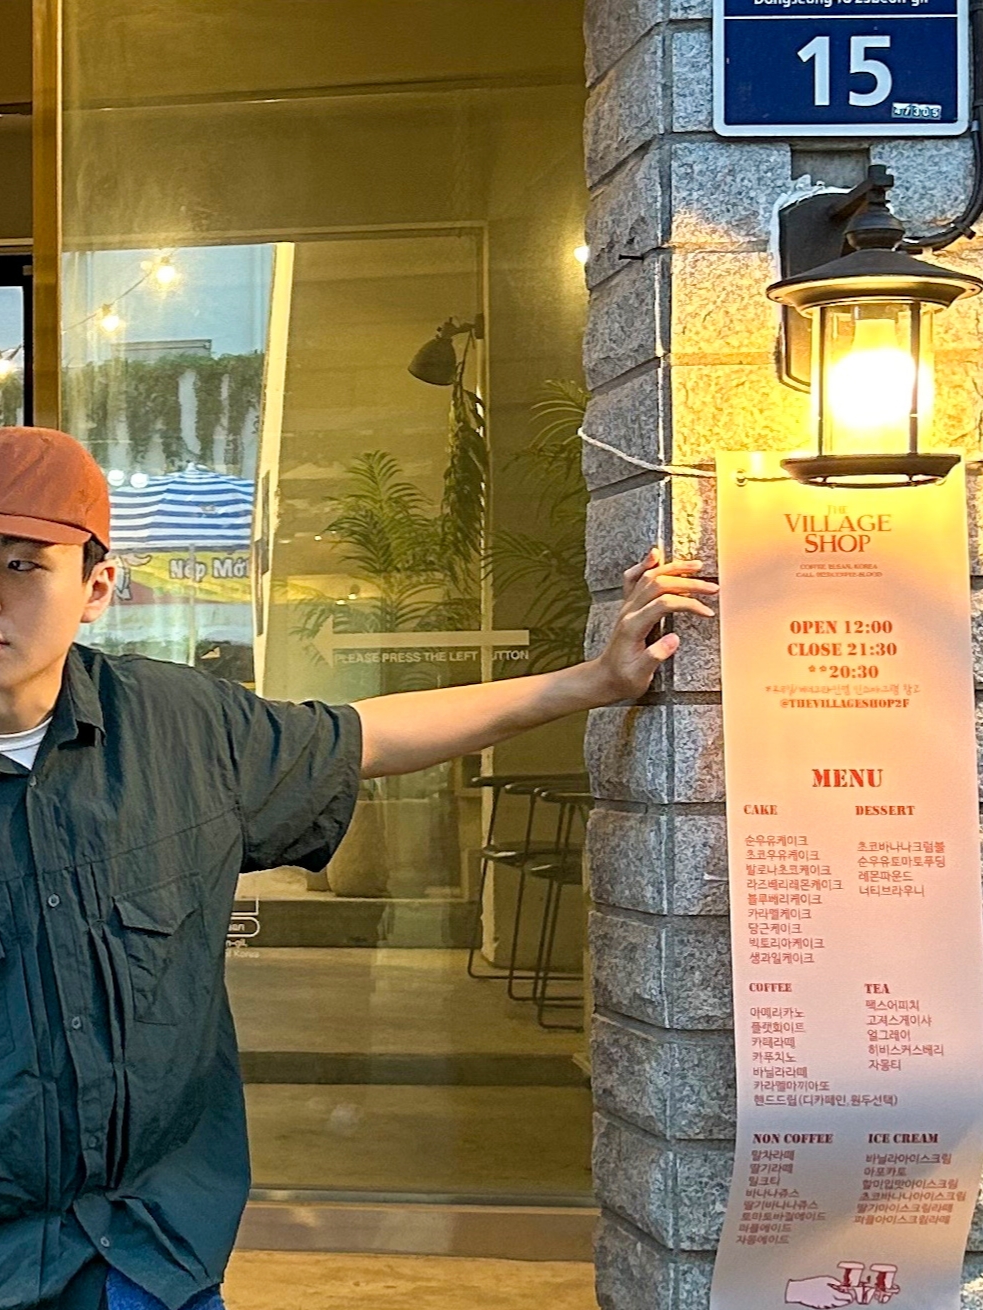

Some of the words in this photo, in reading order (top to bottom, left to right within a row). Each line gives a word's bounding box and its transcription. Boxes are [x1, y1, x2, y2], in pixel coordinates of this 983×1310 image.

[797, 36, 893, 107] 15
[784, 513, 893, 533] VILLAGE
[804, 533, 872, 554] SHOP
[789, 620, 838, 635] OPEN
[844, 620, 893, 634] 12:00
[787, 642, 843, 657] CLOSE
[847, 642, 898, 656] 21:30
[335, 652, 381, 664] PLEASE
[382, 651, 420, 663] PRESS
[424, 651, 447, 662] THE
[449, 650, 479, 662] LEFT
[811, 768, 884, 788] MENU
[743, 804, 778, 815] CAKE
[855, 805, 916, 816] DESSERT
[744, 834, 809, 847] 순우유케이크
[857, 841, 946, 853] 초코바나나크럼블
[745, 849, 821, 861] 초코우유케이크
[857, 855, 946, 868] 순우유토마토푸딩
[858, 870, 914, 883] 레몬파운드
[747, 879, 844, 891] 라즈베리레몬케이크
[859, 884, 925, 897] 너티브라우니
[747, 893, 823, 906] 블루베리케이크
[748, 908, 812, 920] 카라멜케이크
[748, 922, 803, 935] 당근케이크
[749, 937, 825, 950] 빅토리아케이크
[749, 952, 815, 964] 생과일케이크
[748, 982, 793, 993] COFFEE
[864, 983, 891, 994] TEA
[749, 1006, 806, 1019] 아메리카노
[866, 1029, 911, 1041] 얼그레이
[752, 1051, 797, 1064] 카푸치노
[868, 1059, 902, 1071] 자몽티
[753, 1066, 808, 1078] 바닐라라떼
[753, 1081, 830, 1092] 카라멜마끼아또
[753, 1133, 780, 1144] NON
[783, 1133, 834, 1144] COFFEE
[868, 1133, 890, 1144] ICE
[893, 1133, 938, 1144] CREAM
[865, 1153, 952, 1165] 바닐라아이스크림
[749, 1163, 793, 1174] 딸기라떼
